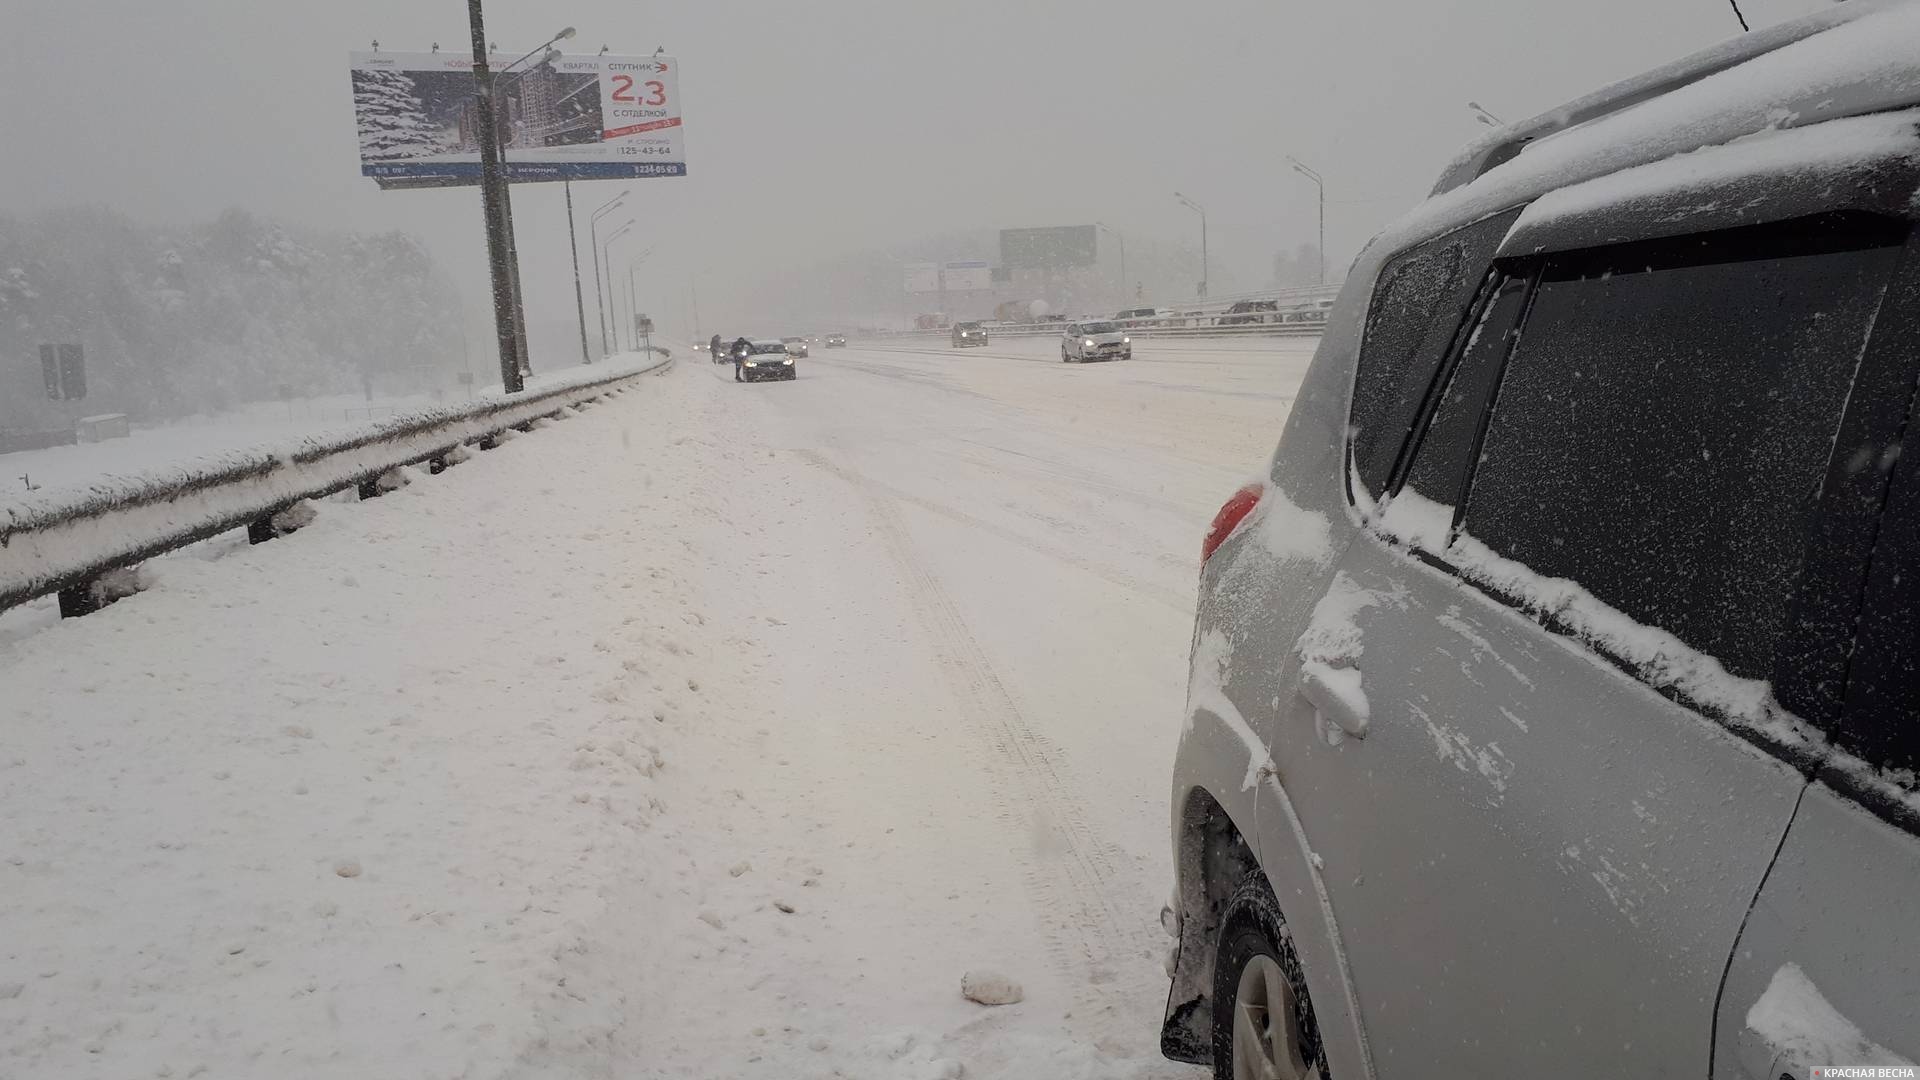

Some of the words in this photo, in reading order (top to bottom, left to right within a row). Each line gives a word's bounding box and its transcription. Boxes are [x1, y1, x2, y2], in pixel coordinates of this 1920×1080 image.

[608, 63, 653, 71] СПУТНИК
[611, 74, 666, 106] 2,3
[621, 109, 667, 118] ОТДЕЛКОЙ
